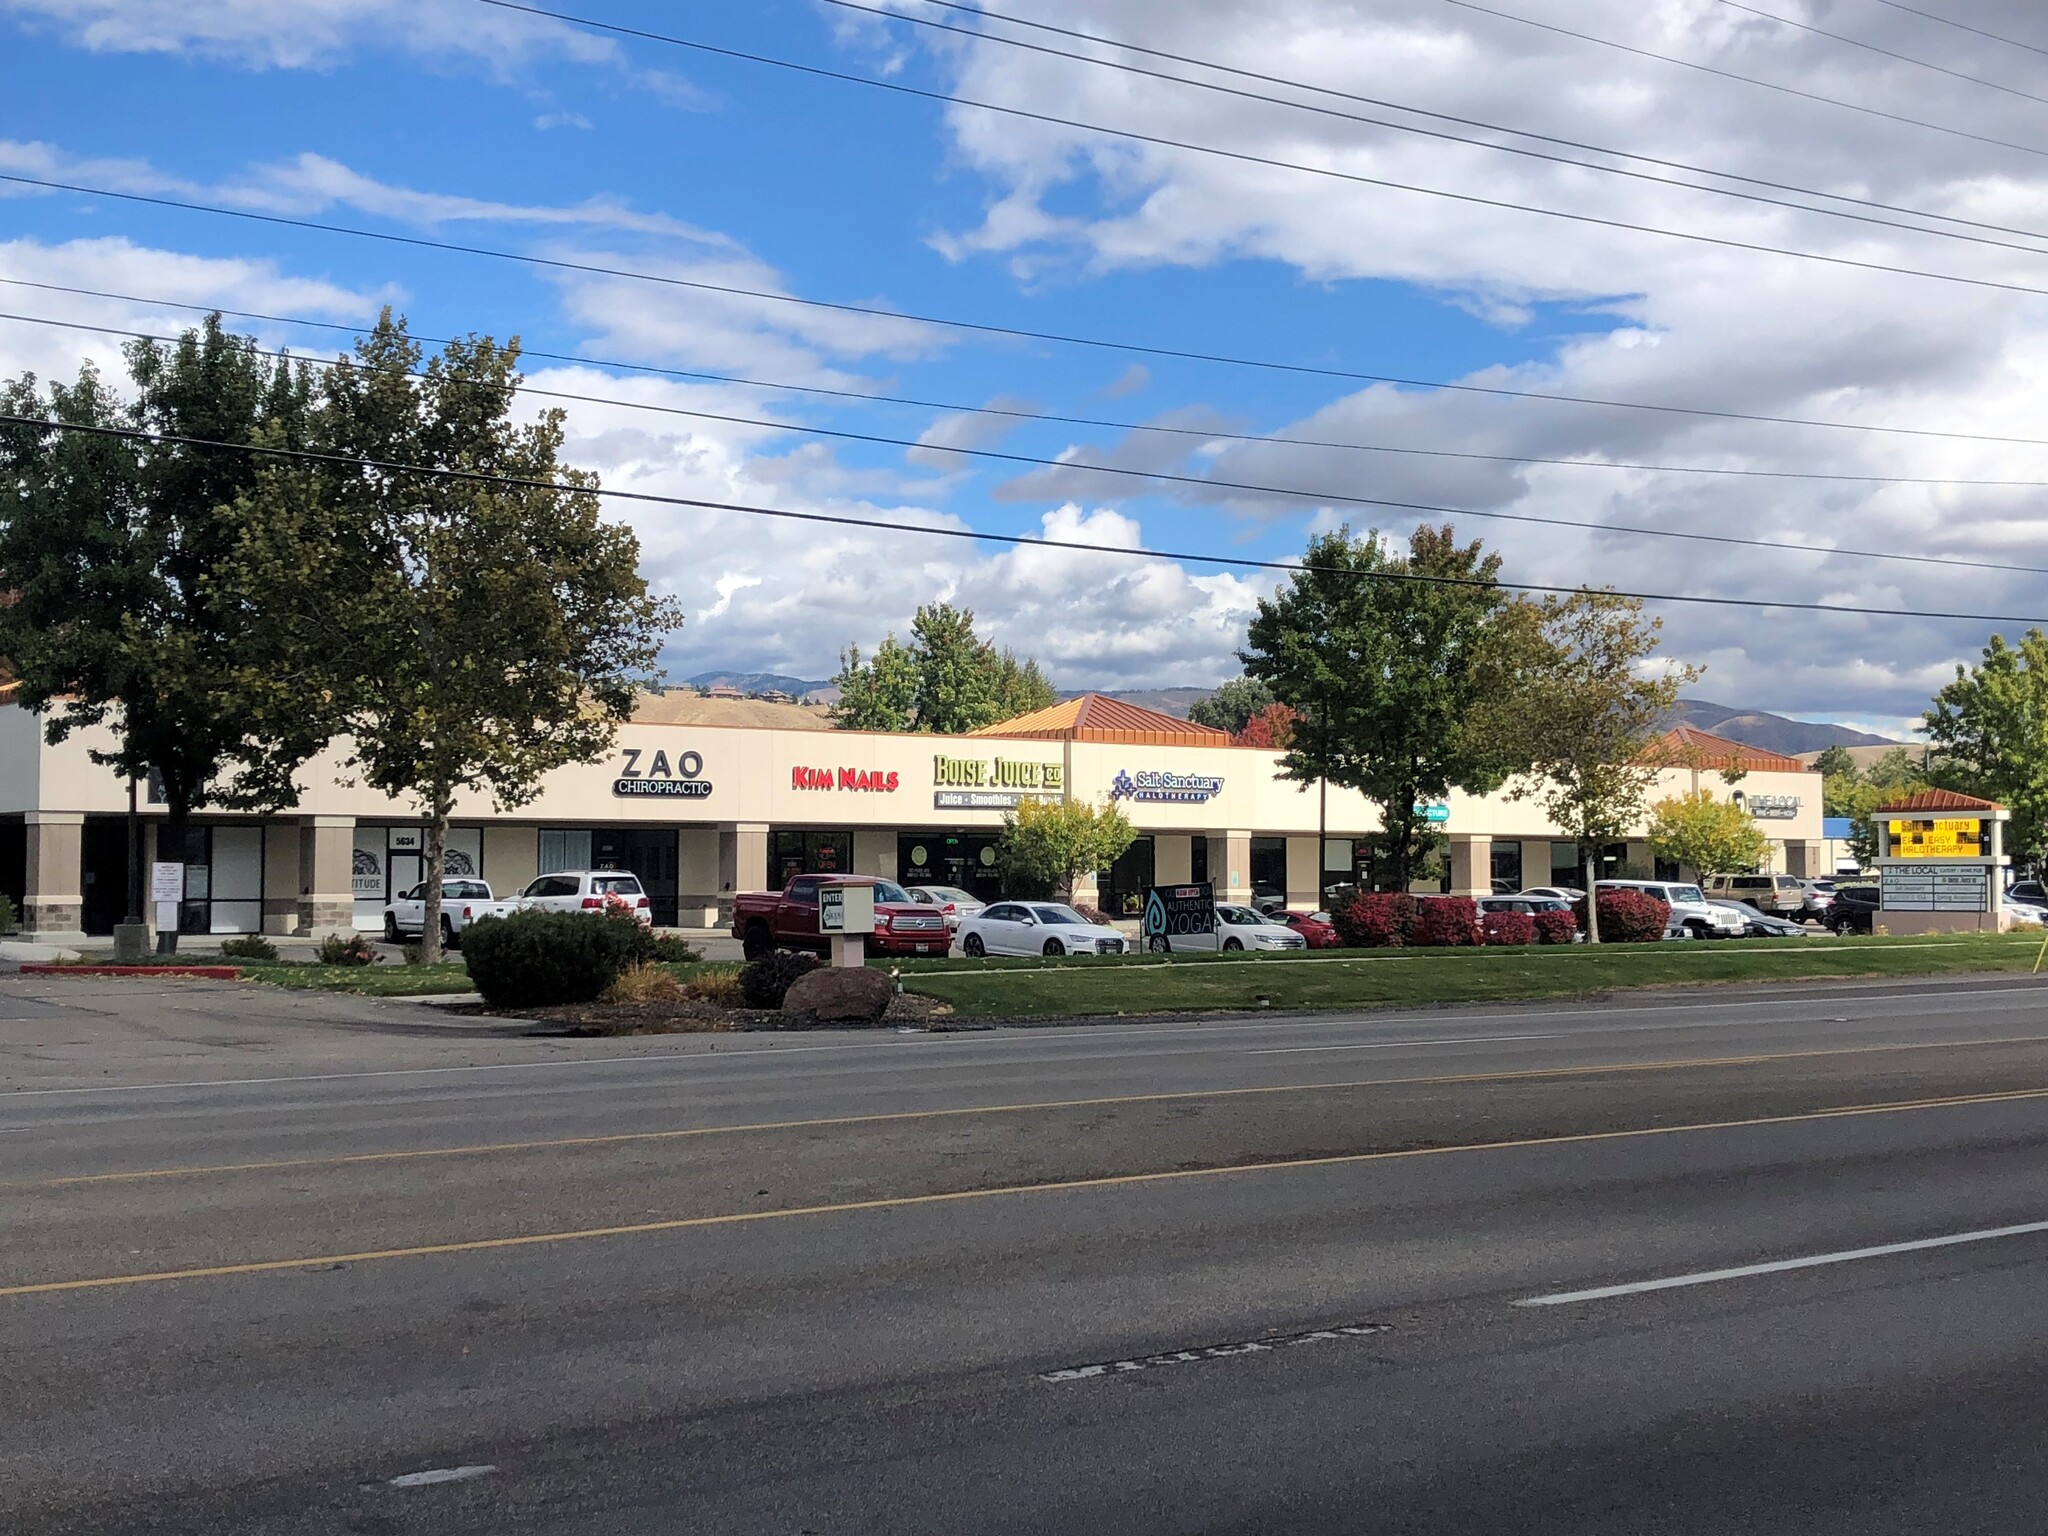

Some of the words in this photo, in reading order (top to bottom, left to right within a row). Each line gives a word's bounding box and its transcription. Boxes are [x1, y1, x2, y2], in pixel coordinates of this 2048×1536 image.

[621, 749, 703, 779] ZAO
[933, 755, 987, 787] BOISE
[990, 757, 1041, 787] JUICE
[792, 766, 834, 791] KIM
[838, 766, 898, 792] NAILS
[1137, 772, 1161, 788] Salt
[1162, 772, 1224, 793] Sanctuary
[618, 781, 710, 794] CHIROPRACTIC
[940, 794, 962, 805] Juice
[970, 794, 1012, 806] Smoothies
[1139, 792, 1208, 800] HALOTHERAPY
[396, 837, 415, 846] 5634
[1928, 834, 1951, 844] EASY
[1902, 843, 1964, 854] HALOTHERAPY
[1894, 866, 1909, 875] THE
[1911, 867, 1938, 875] LOCAL
[351, 879, 381, 889] TITUDE
[1167, 899, 1213, 911] AUTHENTIC
[1167, 912, 1213, 934] YOGA
